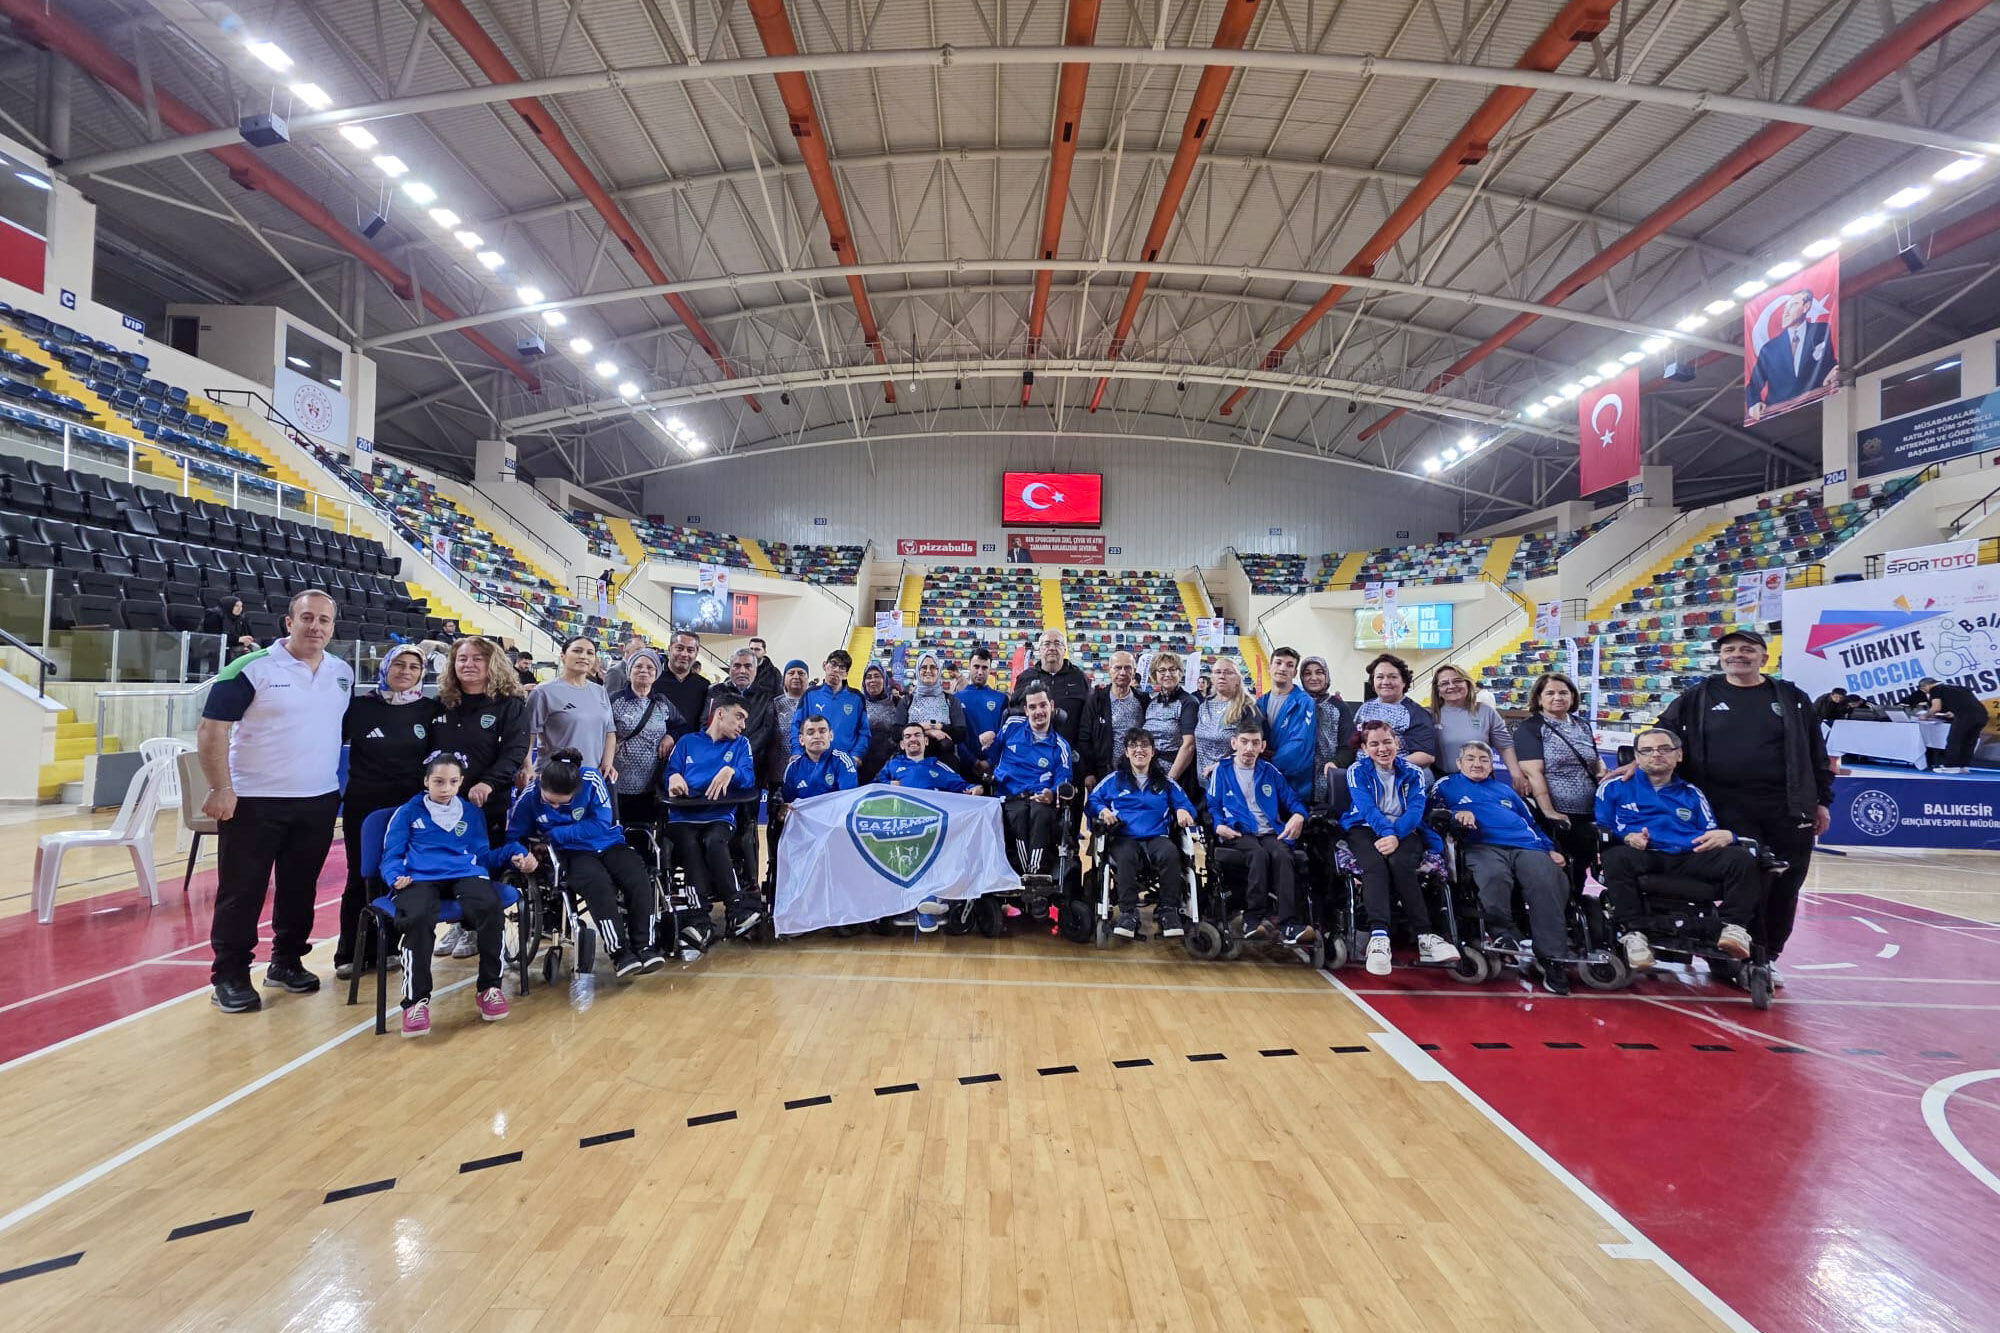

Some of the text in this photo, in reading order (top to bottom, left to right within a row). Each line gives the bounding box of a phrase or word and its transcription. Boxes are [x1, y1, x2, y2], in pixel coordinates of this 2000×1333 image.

[62, 292, 75, 307] C
[124, 317, 142, 330] VIP
[1902, 428, 1935, 442] KATILAN
[1937, 422, 1956, 433] TÜM
[358, 439, 372, 453] 201
[1894, 437, 1936, 453] ANTRENÖR
[1936, 433, 1948, 442] VE
[1907, 442, 1951, 458] BAŞARILAR
[1825, 470, 1845, 485] 204
[919, 542, 974, 554] pizzabulls
[1839, 630, 1925, 668] TÜRKİYE
[1845, 658, 1926, 692] BOCCIA
[1924, 803, 1993, 817] BALIKESİR
[1901, 817, 1931, 828] GENÇLİK
[1932, 818, 1943, 827] VE
[1943, 819, 1962, 827] SPOR
